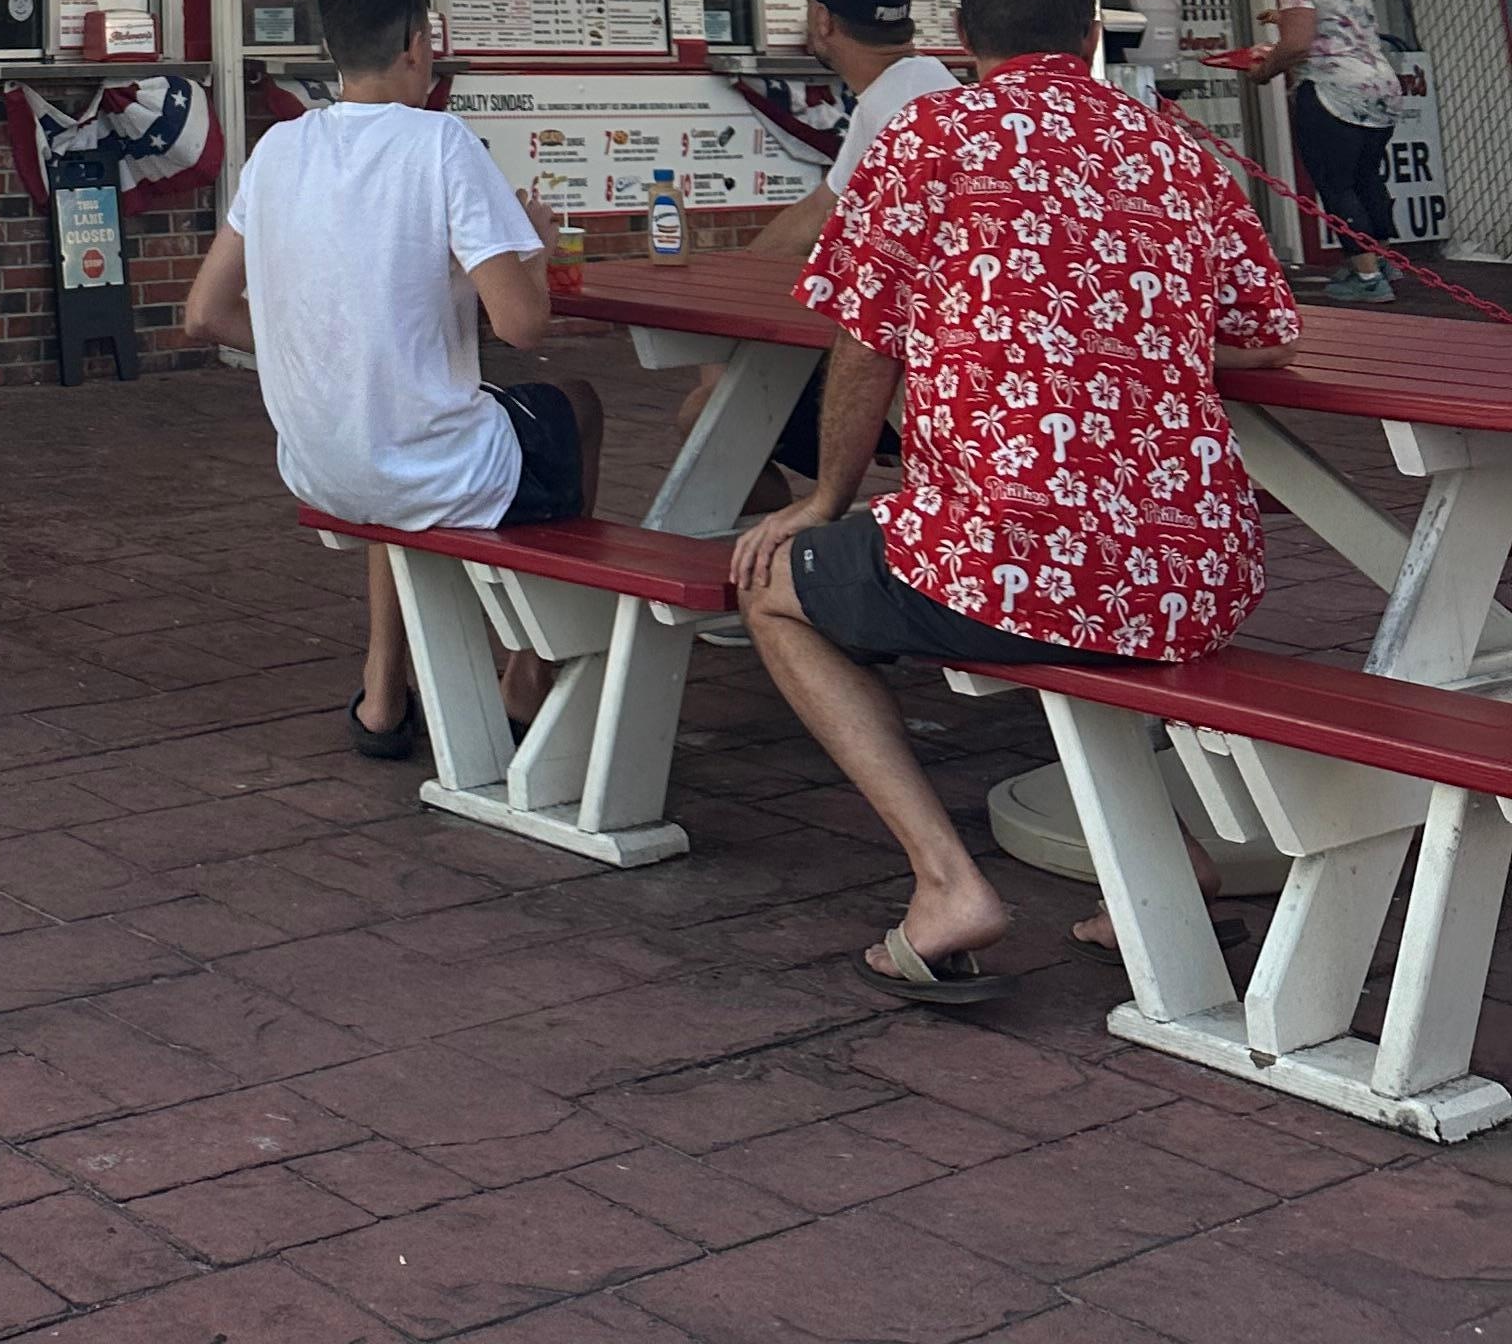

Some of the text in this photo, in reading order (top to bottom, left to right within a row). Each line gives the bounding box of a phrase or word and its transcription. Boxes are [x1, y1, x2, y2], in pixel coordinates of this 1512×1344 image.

[490, 94, 534, 112] SUNDAES
[1001, 112, 1036, 154] P
[1150, 140, 1176, 182] P
[949, 171, 1013, 195] Phillies
[74, 213, 105, 226] LANE
[77, 199, 99, 211] THIS
[1408, 194, 1447, 237] UP
[65, 228, 115, 245] CLOSED
[969, 254, 1002, 301] P
[1129, 270, 1163, 319] P
[1039, 412, 1077, 464] P
[1190, 435, 1222, 487] P
[992, 564, 1030, 612] P
[1159, 592, 1188, 642] P
